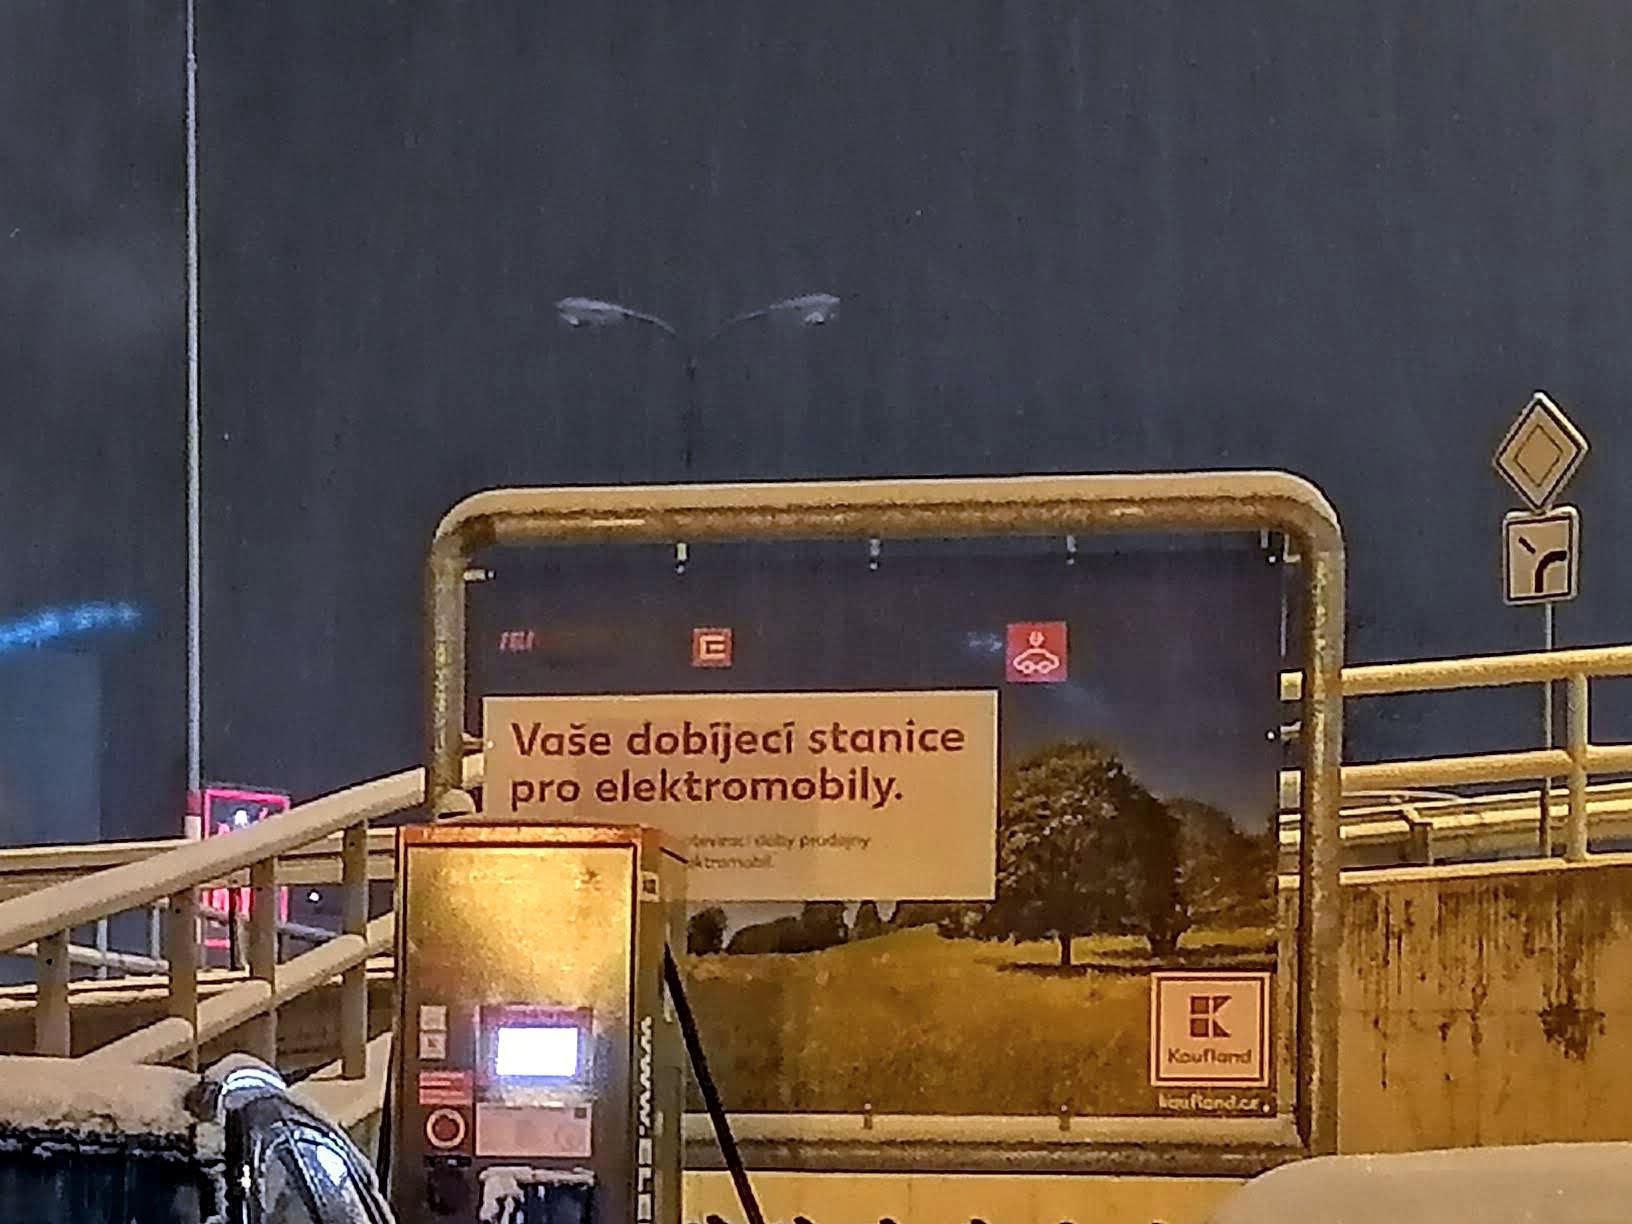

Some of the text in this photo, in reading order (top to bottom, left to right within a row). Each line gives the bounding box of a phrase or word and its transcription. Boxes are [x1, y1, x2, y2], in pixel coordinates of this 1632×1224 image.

[510, 719, 966, 763] Vaše dobíjecí stanice
[510, 766, 903, 811] pro elektromobily.
[1167, 1048, 1253, 1064] Kaufland
